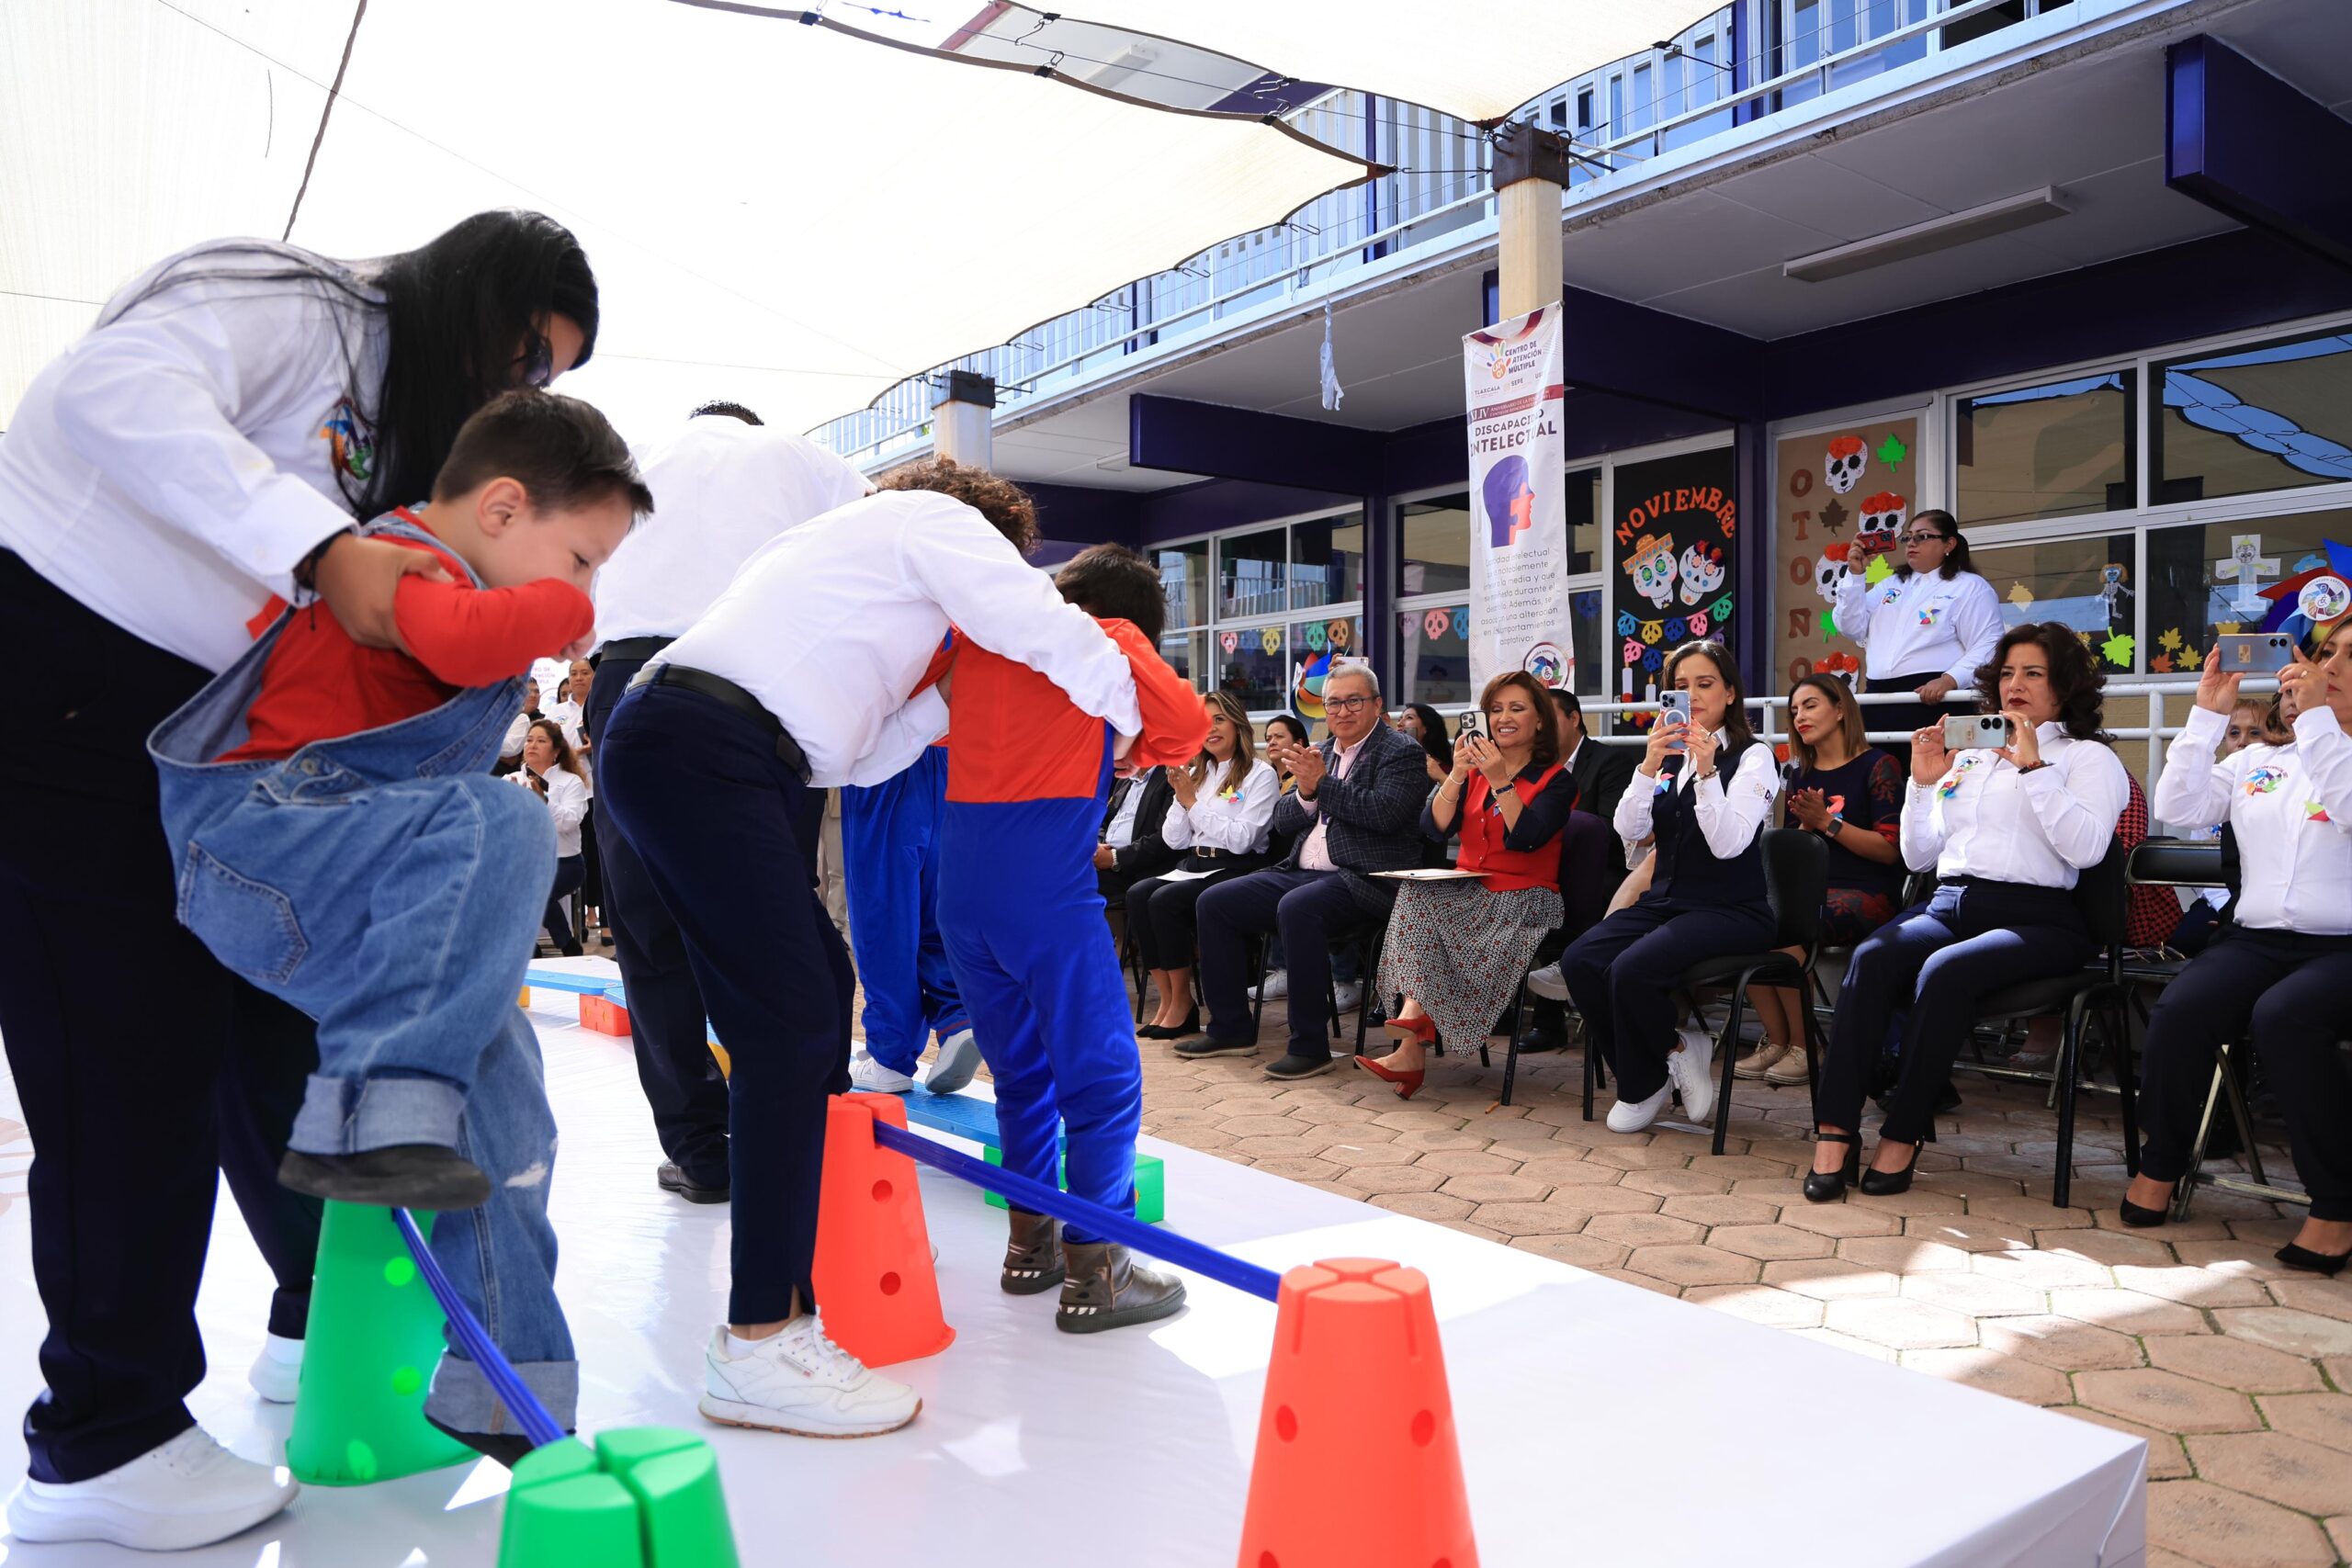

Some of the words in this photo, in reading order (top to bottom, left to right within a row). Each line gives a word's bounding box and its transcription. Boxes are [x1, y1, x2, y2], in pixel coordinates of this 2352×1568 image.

[1505, 344, 1528, 356] CENTRO
[1529, 341, 1537, 349] DE
[1512, 348, 1542, 364] ATENCIÓN
[1508, 360, 1535, 374] MÚLTIPLE
[1510, 378, 1523, 386] SEPE
[1475, 386, 1500, 395] TLAXCALA
[1470, 421, 1557, 457] INTELECTUAL
[1615, 487, 1736, 547] NOVIEMBRE
[1508, 575, 1532, 584] media
[1533, 574, 1539, 582] y
[1541, 571, 1555, 581] que
[1514, 585, 1547, 595] durante
[1548, 582, 1555, 591] el
[1509, 597, 1544, 608] Además,
